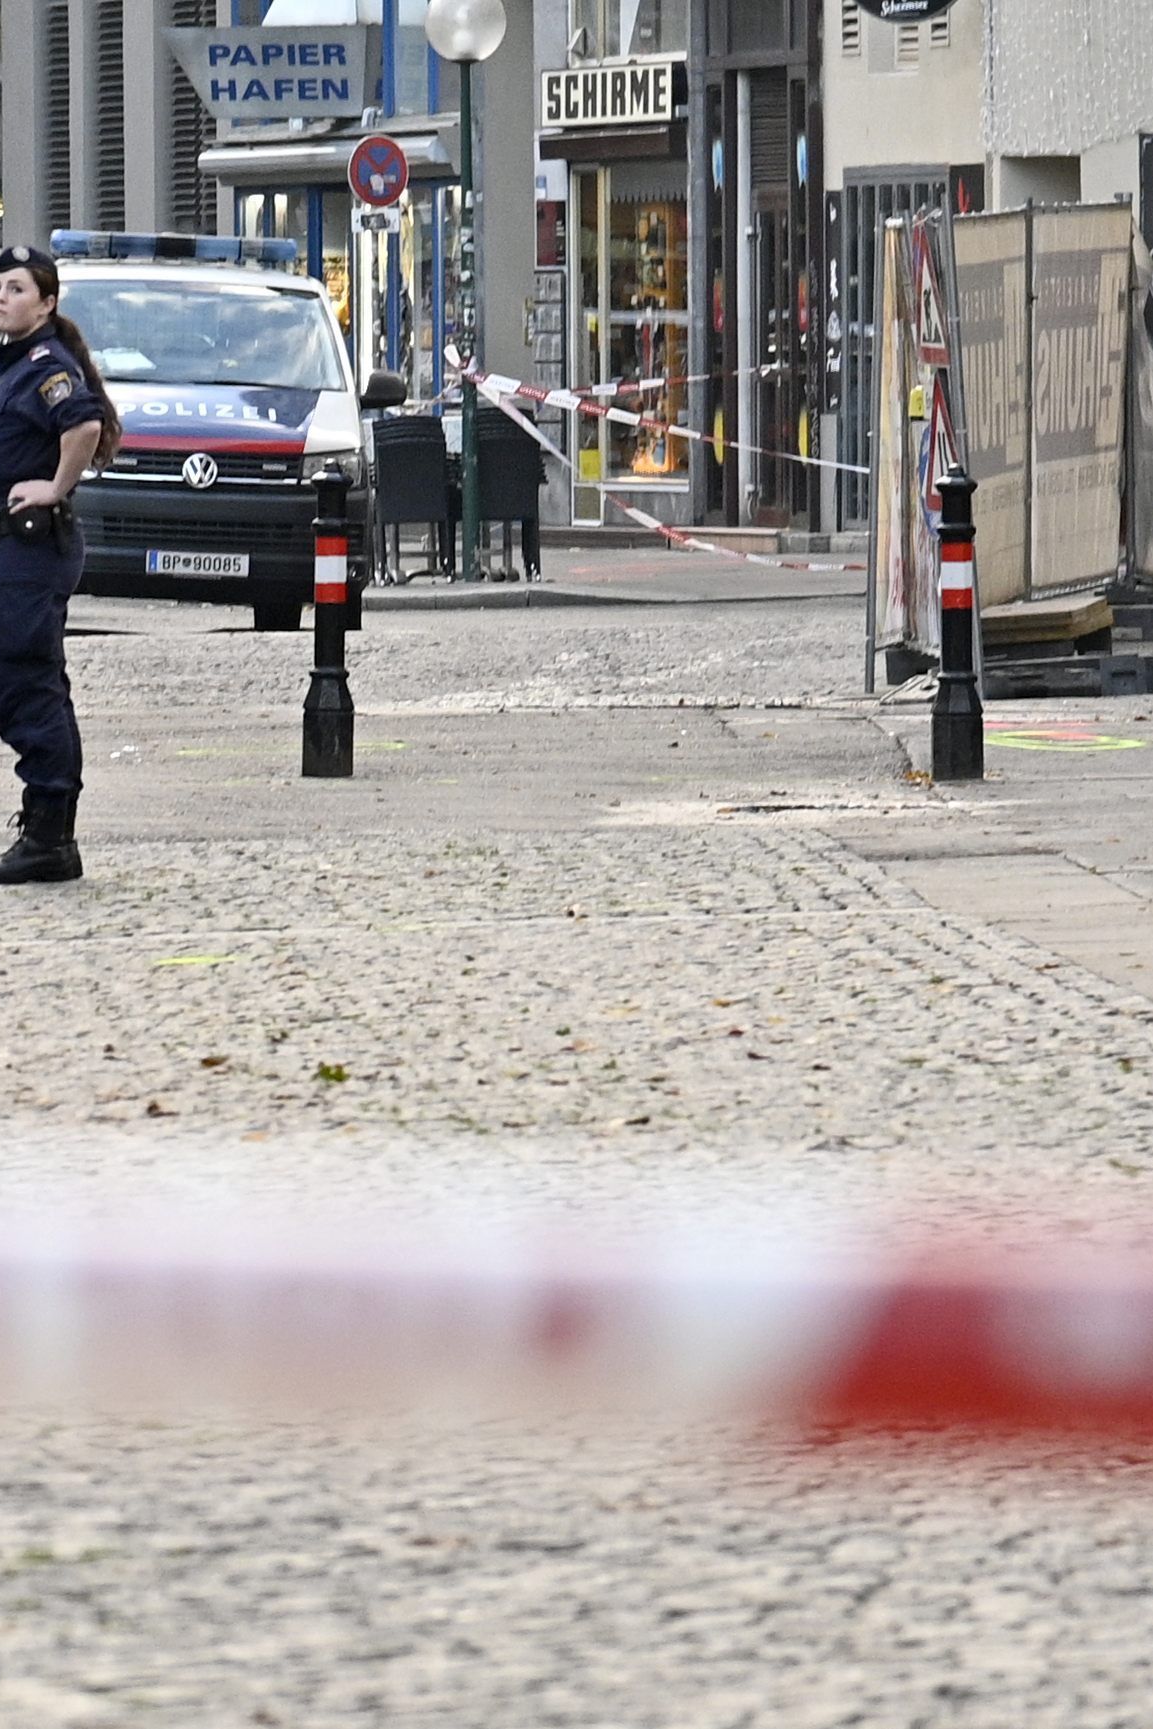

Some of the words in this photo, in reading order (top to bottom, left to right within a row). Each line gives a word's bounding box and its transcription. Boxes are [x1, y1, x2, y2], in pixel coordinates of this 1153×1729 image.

[208, 44, 347, 67] PAPIER
[210, 78, 349, 102] HAFEN
[547, 68, 667, 120] SCHIRME
[116, 402, 278, 423] POLIZEI
[192, 556, 242, 573] 90085
